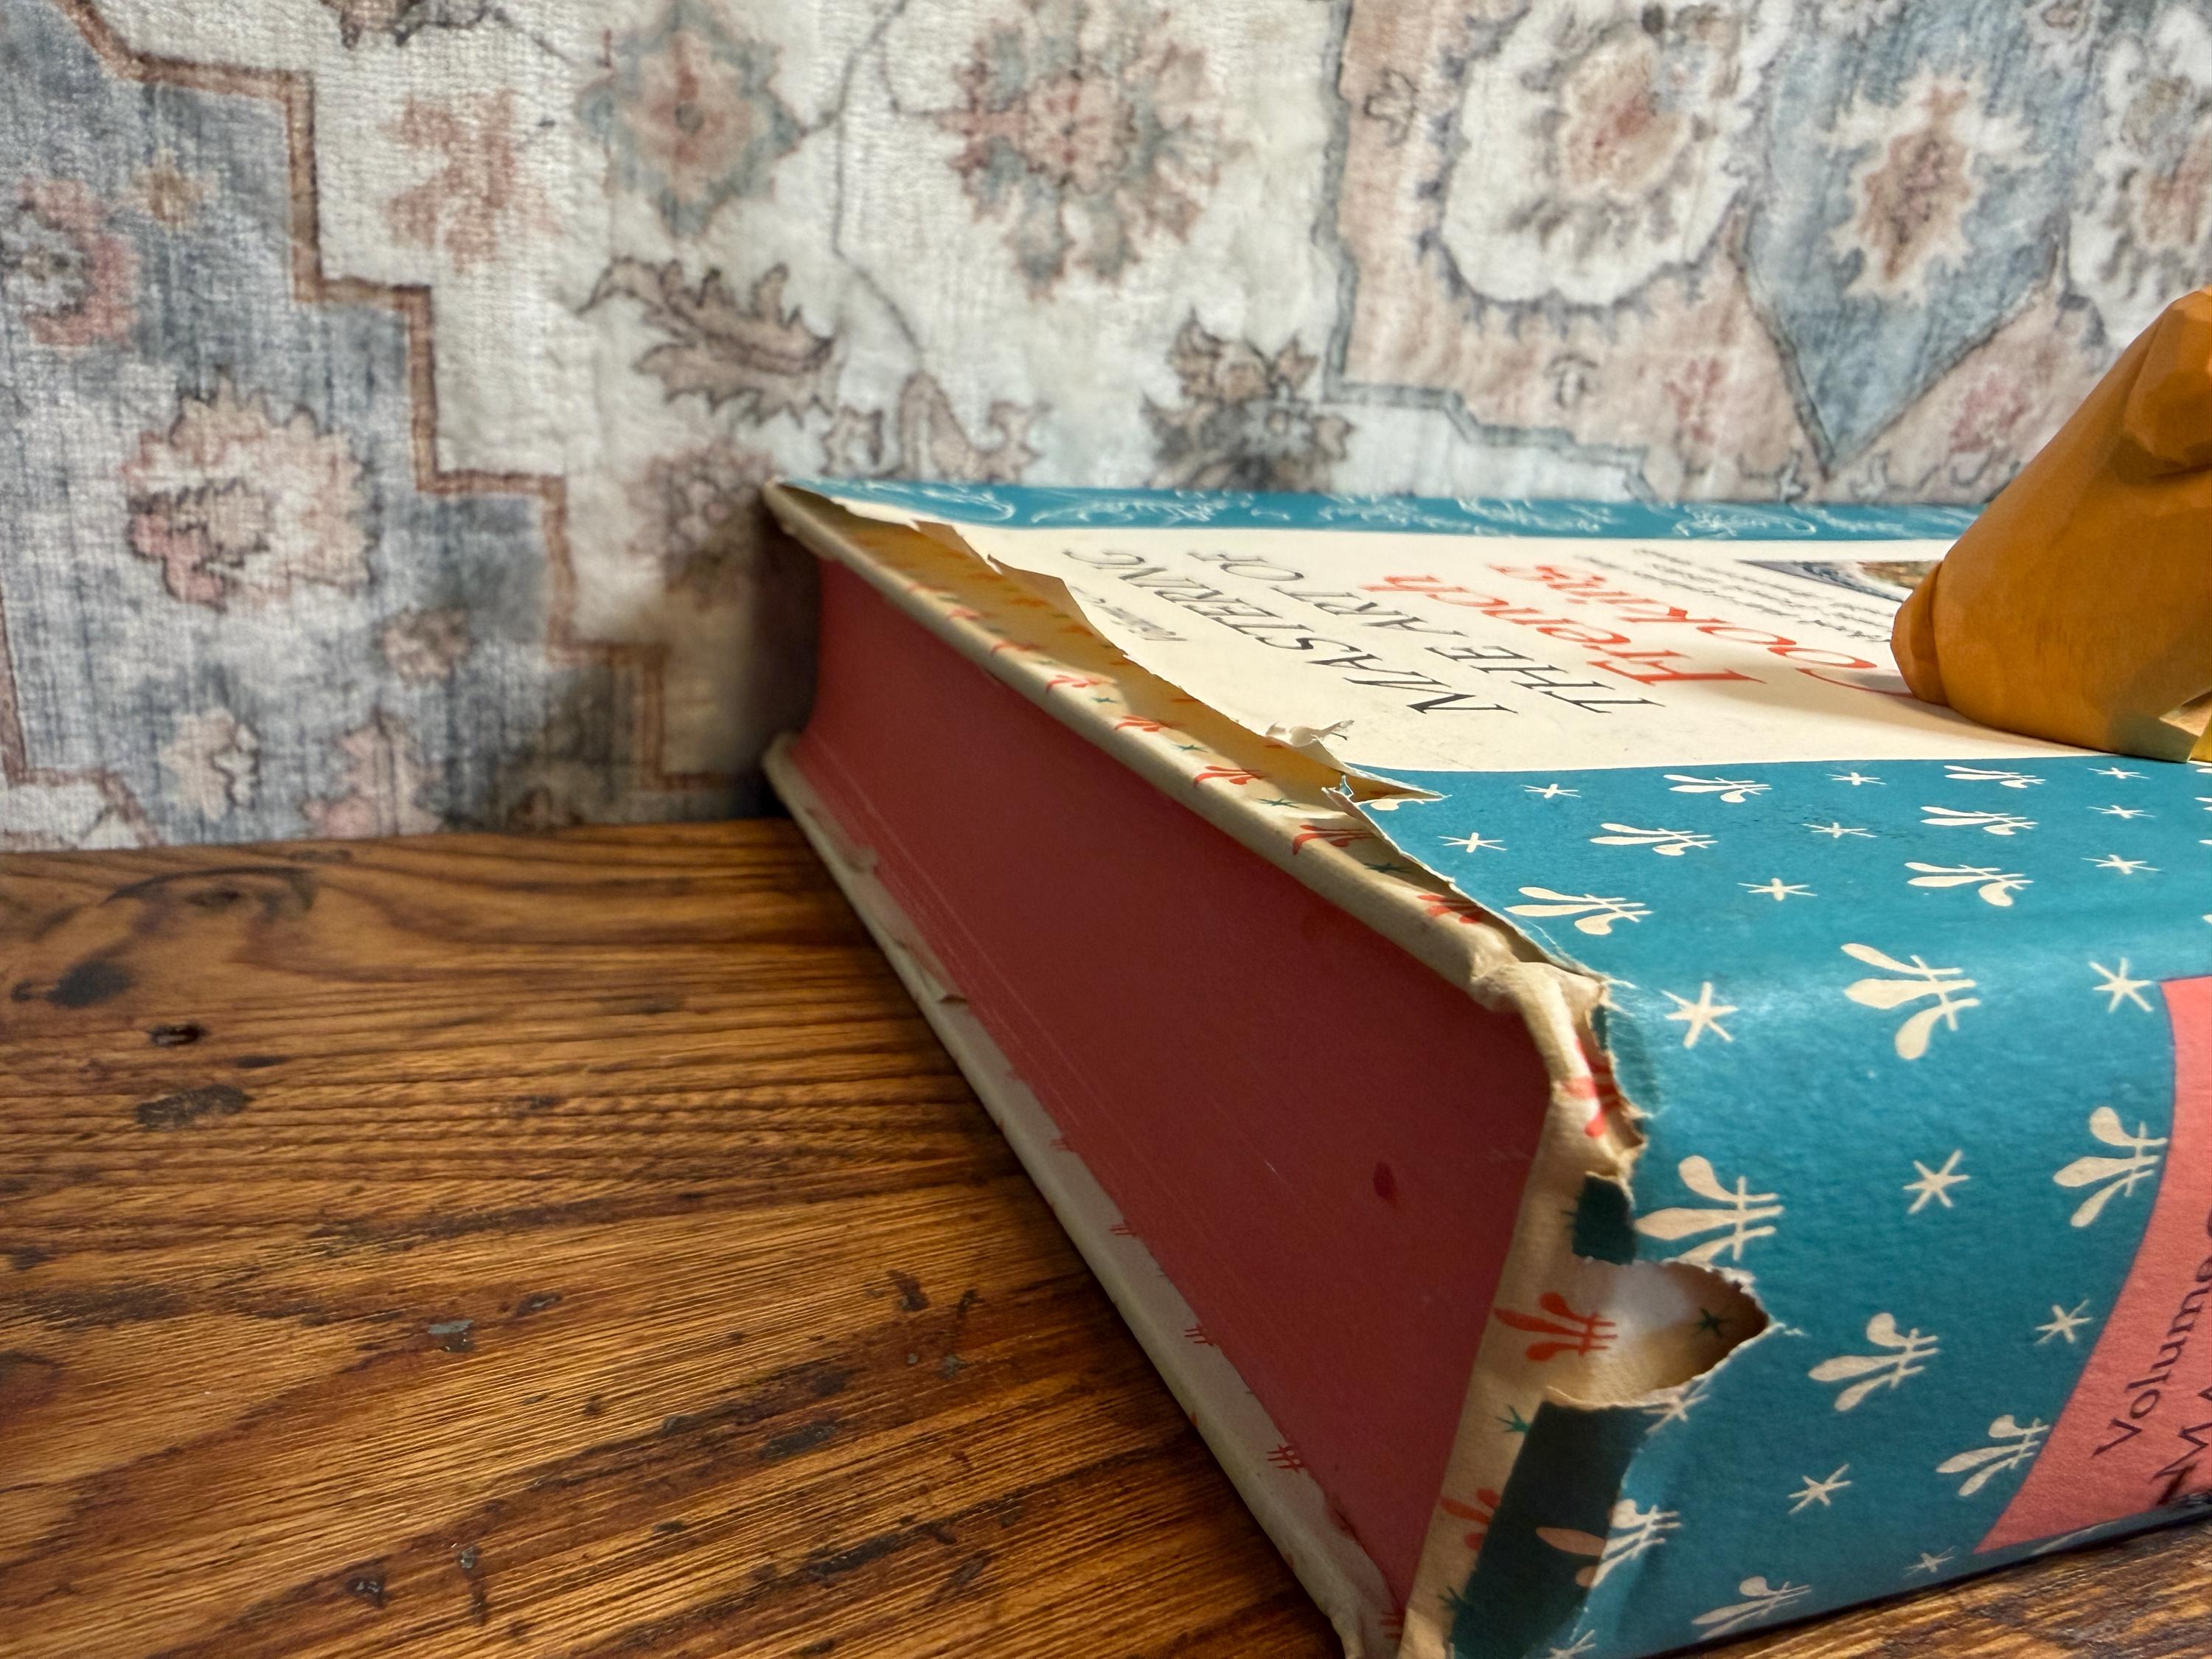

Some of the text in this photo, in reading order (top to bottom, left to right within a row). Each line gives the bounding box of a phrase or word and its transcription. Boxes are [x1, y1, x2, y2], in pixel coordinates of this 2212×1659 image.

[1062, 548, 1519, 715] MASTERING
[1186, 551, 1666, 714] THE ART OF
[1358, 574, 1768, 686] French
